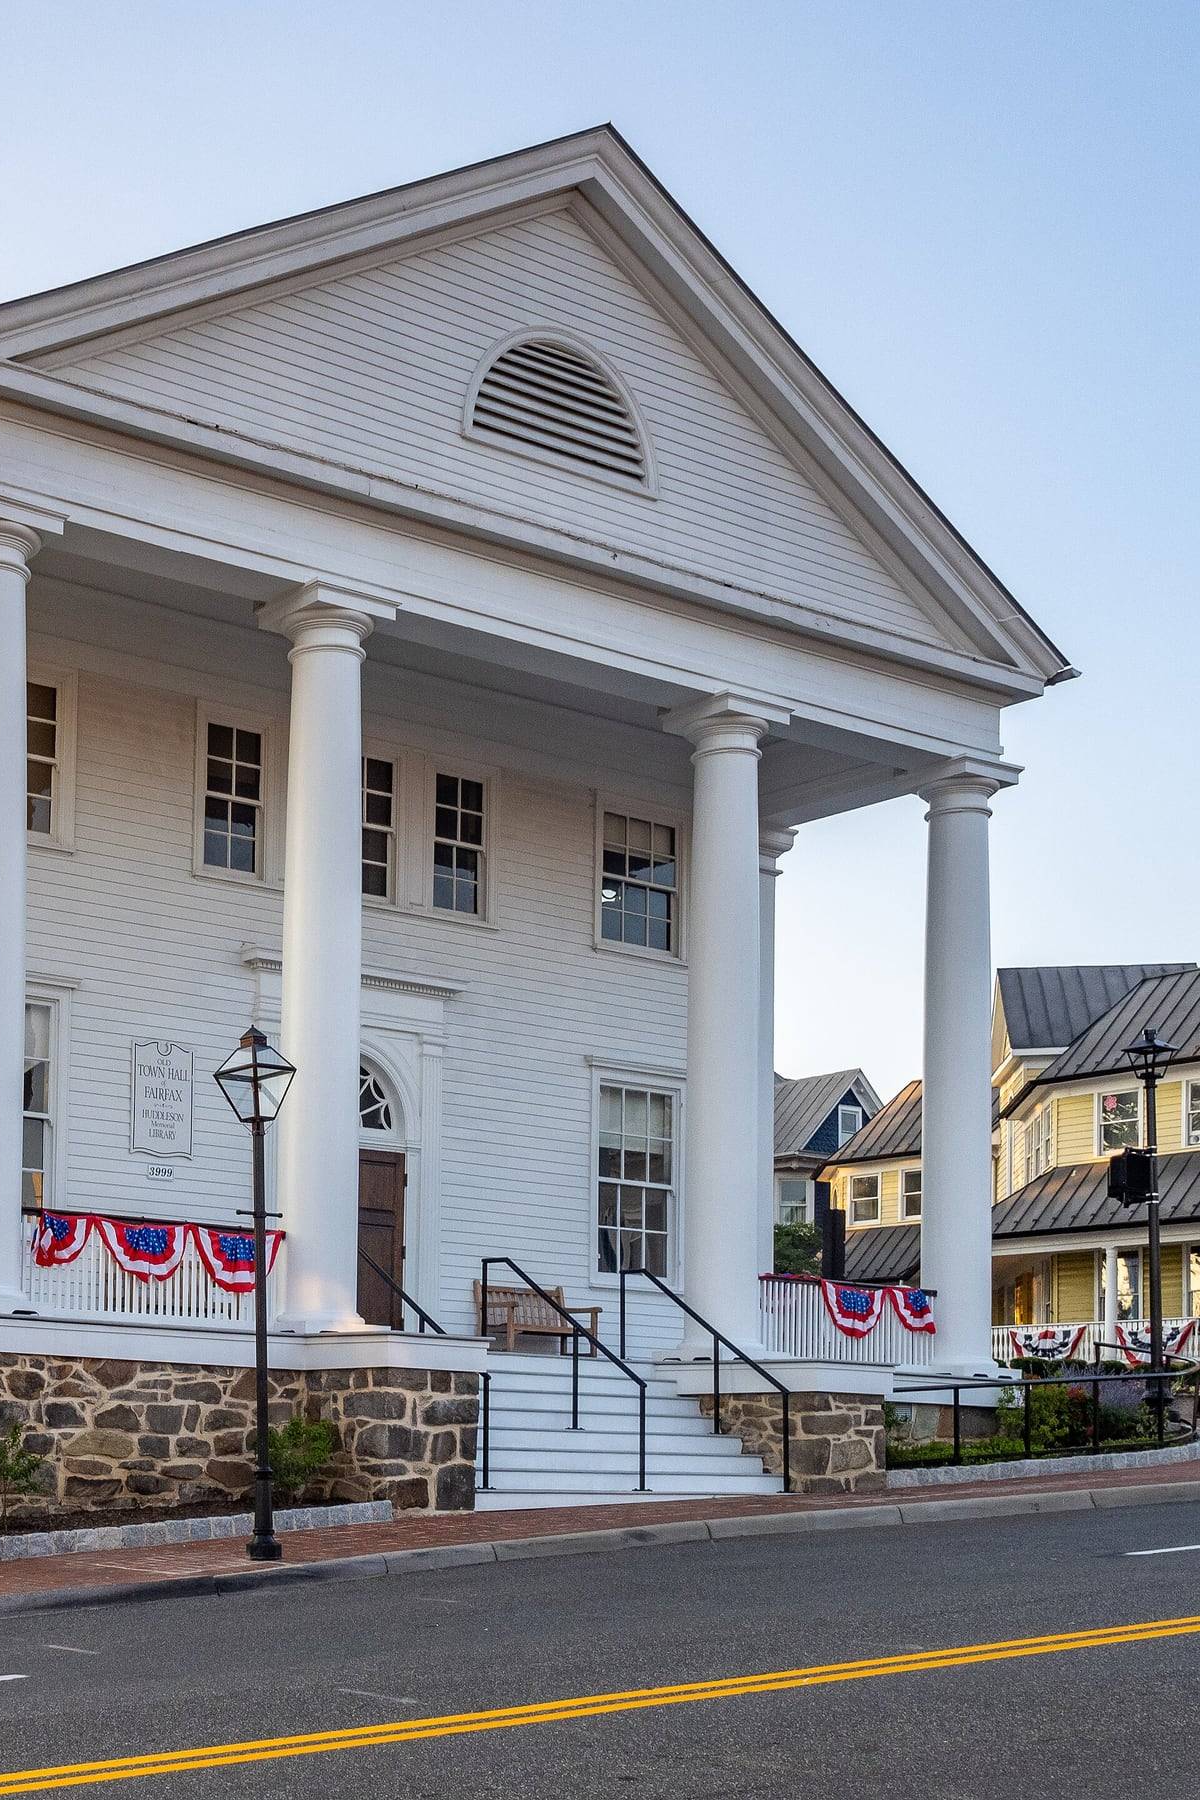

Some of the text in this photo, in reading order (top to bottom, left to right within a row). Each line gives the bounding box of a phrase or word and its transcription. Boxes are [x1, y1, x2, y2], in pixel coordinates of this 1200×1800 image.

[156, 1058, 172, 1066] OLD
[138, 1064, 190, 1082] TOWN HALL
[161, 1079, 167, 1088] of
[144, 1086, 183, 1102] FAIRFAX
[142, 1109, 184, 1123] HUDDLESON
[151, 1120, 175, 1129] Memorial
[148, 1128, 177, 1140] LIBRARY
[149, 1166, 173, 1178] 3999
